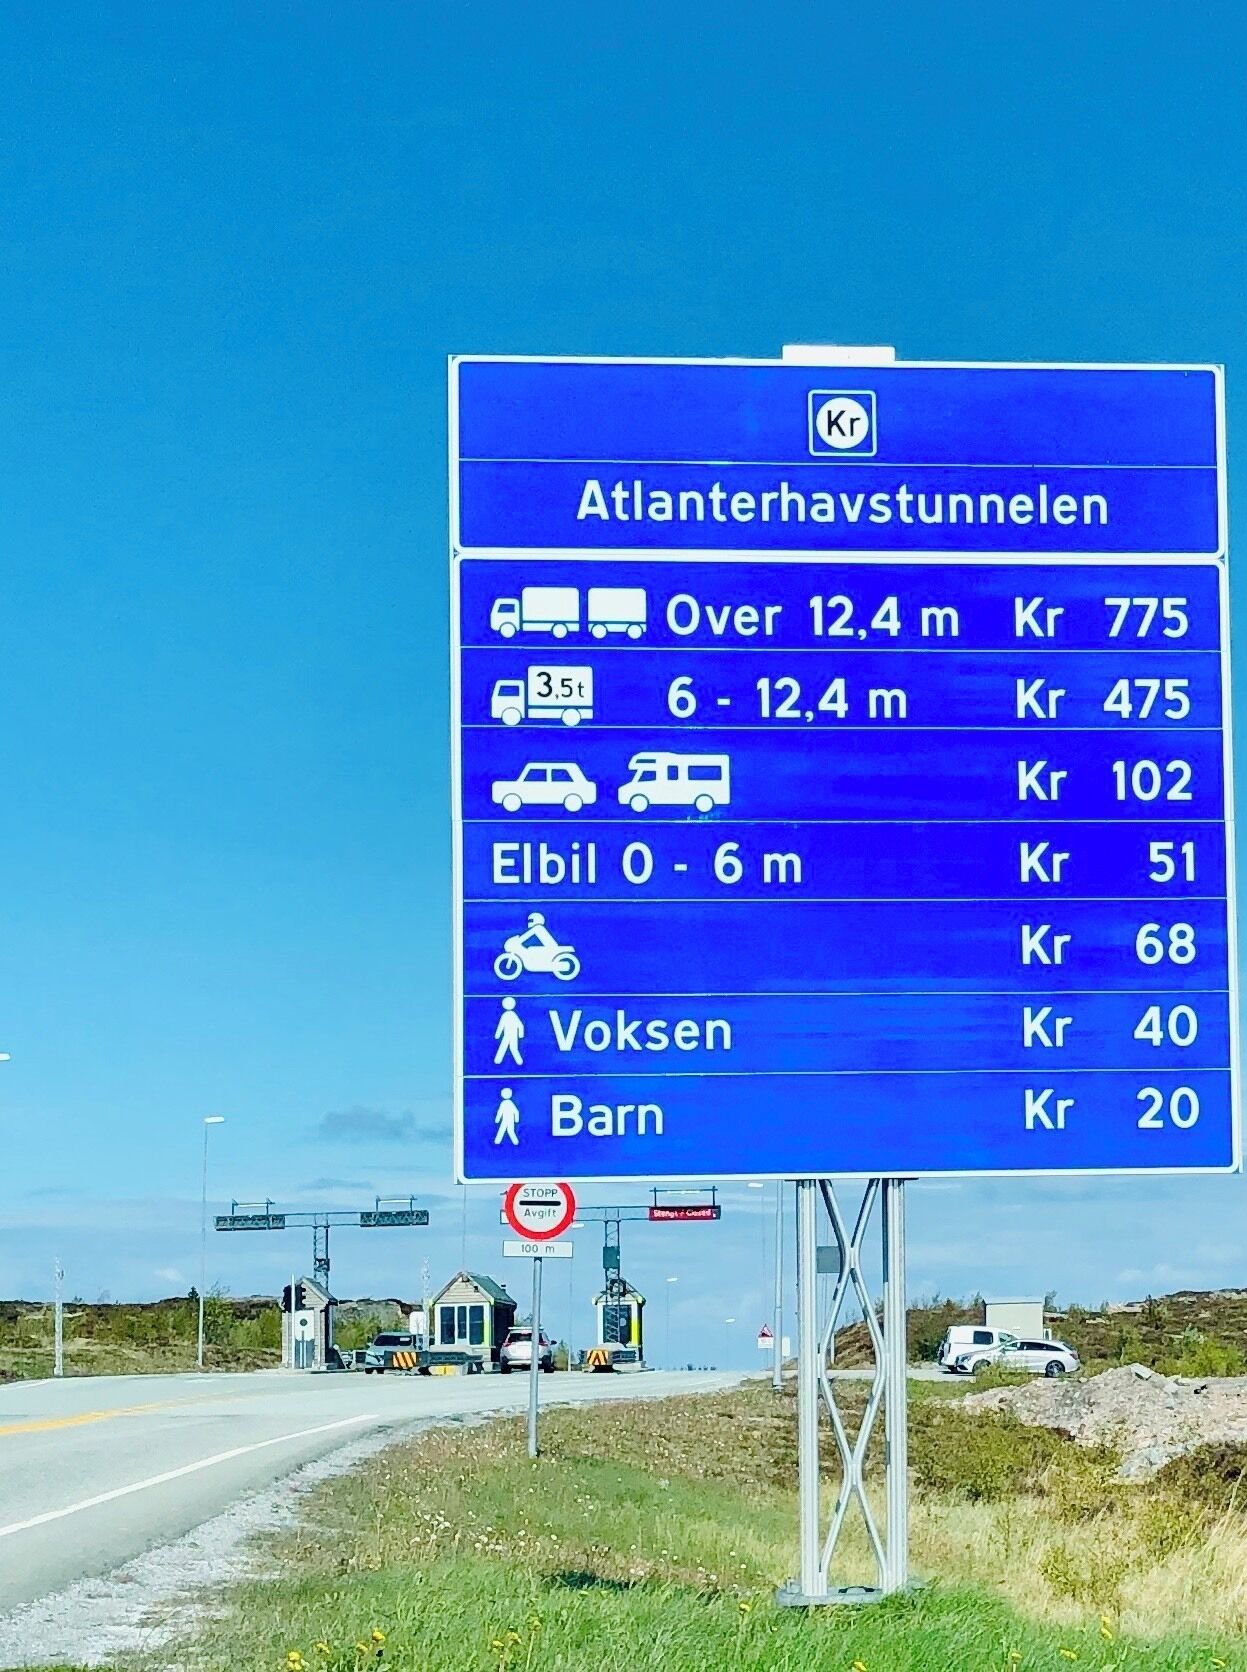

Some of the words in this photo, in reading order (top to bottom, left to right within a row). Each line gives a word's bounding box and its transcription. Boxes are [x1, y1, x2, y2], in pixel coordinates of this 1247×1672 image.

[826, 409, 861, 437] Kr
[576, 479, 1109, 525] Atlanterhavstunnelen
[666, 593, 783, 636] Over
[809, 595, 901, 641] 12,4
[921, 606, 959, 637] m
[1014, 597, 1065, 638] Kr
[1104, 597, 1189, 638] 775
[667, 676, 697, 719] 6
[717, 698, 731, 706] -
[756, 676, 849, 723] 12,4
[868, 688, 907, 719] m
[1016, 678, 1066, 719] Kr
[1103, 678, 1190, 720] 475
[1017, 760, 1068, 801] Kr
[1112, 759, 1193, 801] 102
[493, 842, 596, 885] Elbil
[622, 841, 654, 884] 0
[674, 863, 688, 871] -
[714, 841, 743, 884] 6
[763, 852, 802, 883] m
[1020, 842, 1070, 883] Kr
[1149, 841, 1195, 883] 51
[1021, 924, 1072, 965] Kr
[1135, 922, 1196, 965] 68
[549, 1009, 731, 1052] Voksen
[1023, 1006, 1073, 1048] Kr
[1133, 1004, 1198, 1047] 40
[551, 1094, 663, 1137] Barn
[1024, 1088, 1075, 1130] Kr
[1136, 1086, 1200, 1129] 20
[523, 1188, 558, 1198] STOPP
[523, 1208, 558, 1219] Avgift
[521, 1244, 539, 1254] 100
[545, 1245, 556, 1254] m
